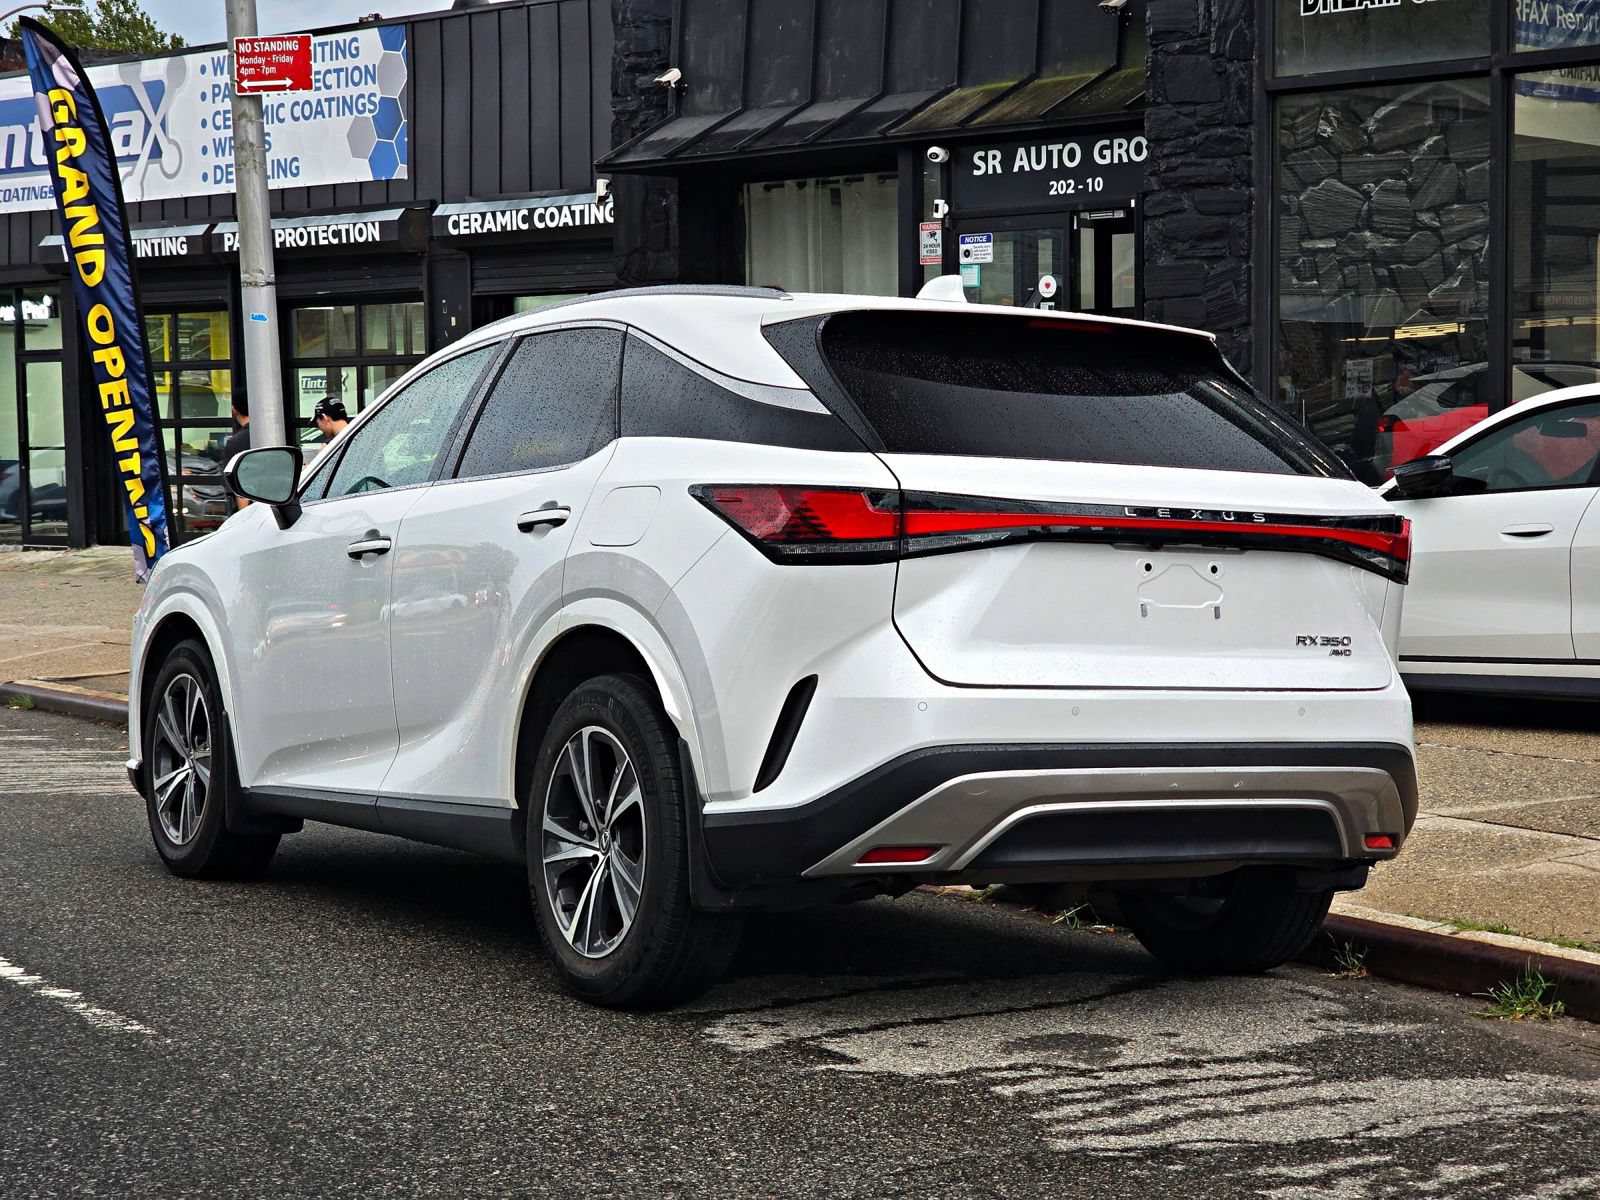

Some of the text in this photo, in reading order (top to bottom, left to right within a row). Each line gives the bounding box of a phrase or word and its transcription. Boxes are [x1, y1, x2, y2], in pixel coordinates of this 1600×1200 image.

[1556, 4, 1599, 33] Report
[239, 40, 299, 53] NO STANDING
[239, 55, 265, 65] Monday
[272, 54, 294, 64] Friday
[240, 66, 255, 76] 4pm
[261, 65, 276, 75] 7pm
[313, 64, 377, 92] ECTION
[212, 92, 379, 131] CEMIC COATINGS
[972, 136, 1148, 176] SR AUTO GRO
[47, 88, 106, 288] GRAND
[448, 202, 614, 235] CERAMIC COATING
[275, 221, 380, 249] PROTECTION
[965, 235, 988, 243] NOTICE
[1124, 506, 1266, 523] LEXUS
[1329, 648, 1352, 656] AWD
